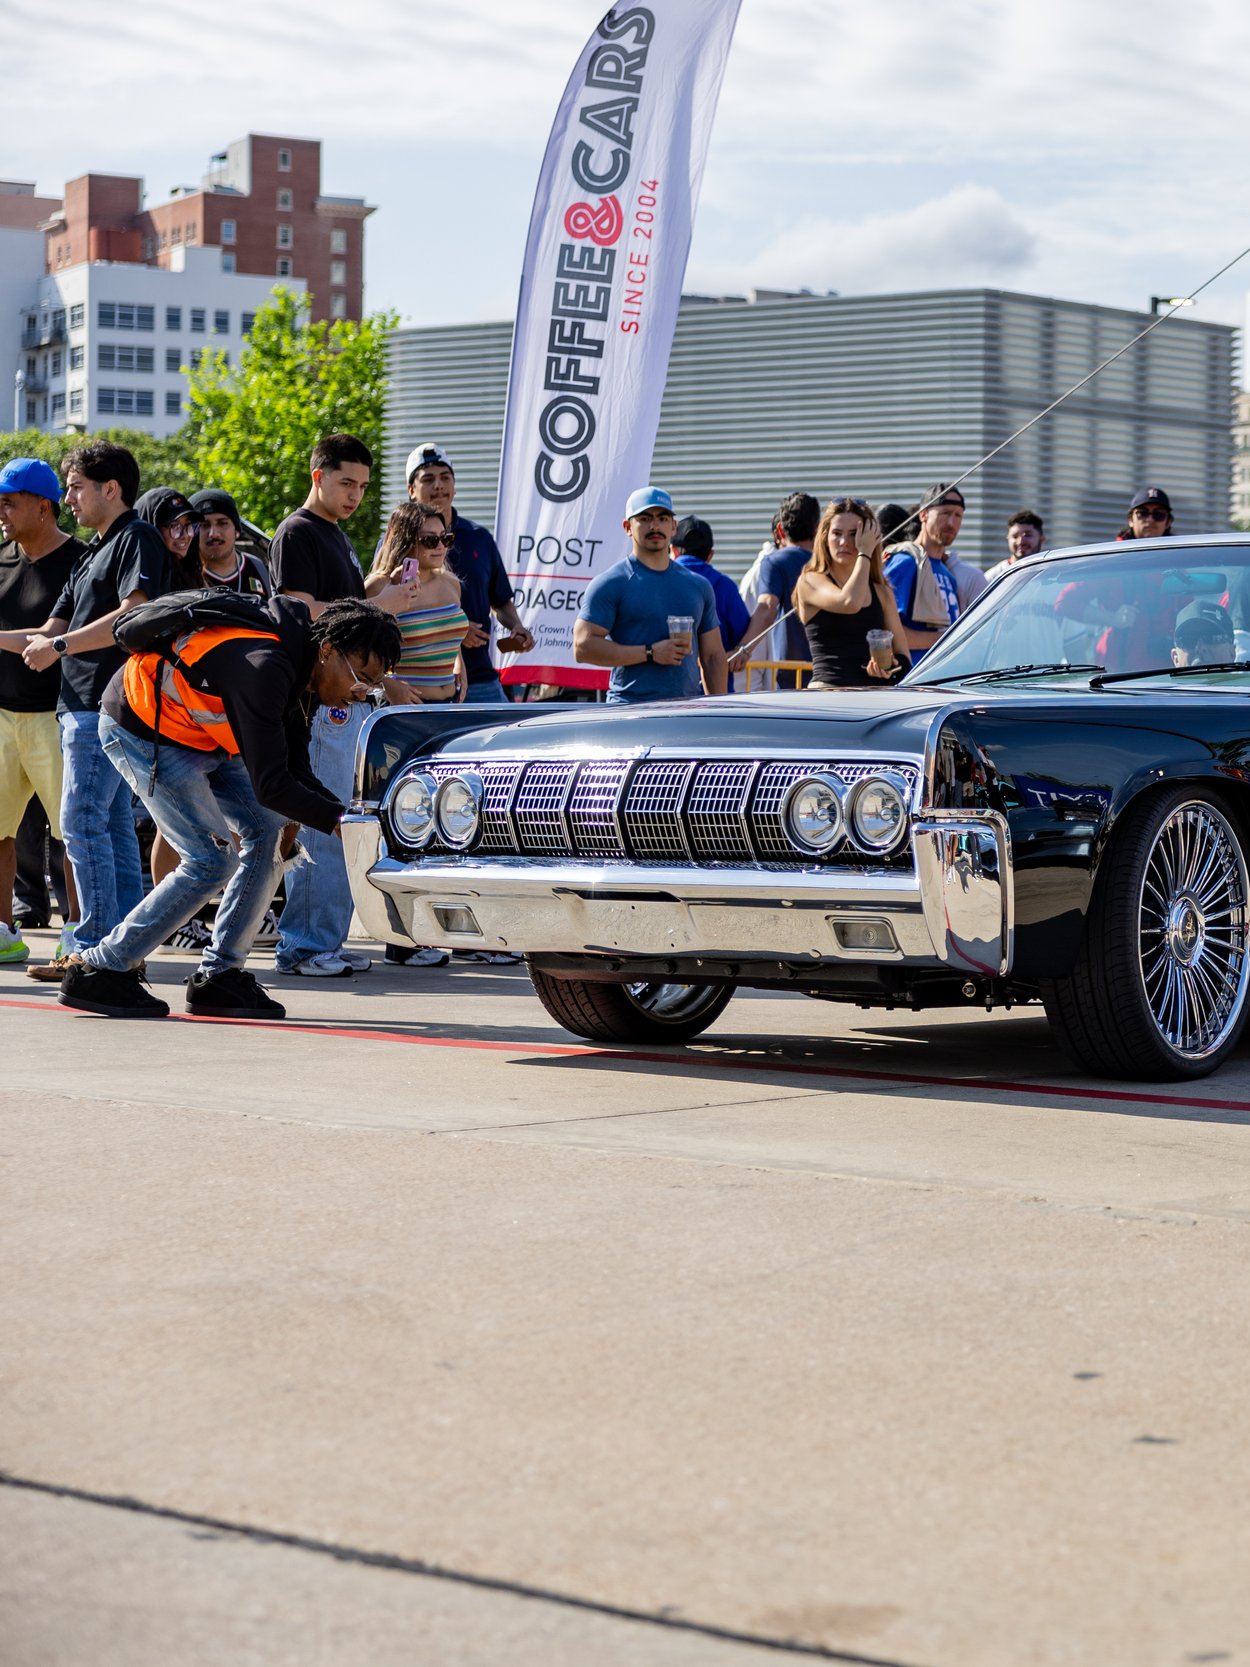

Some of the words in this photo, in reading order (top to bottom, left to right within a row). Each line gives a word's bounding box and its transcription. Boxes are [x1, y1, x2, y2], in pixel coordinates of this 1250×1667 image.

[633, 179, 659, 240] 2004
[620, 252, 649, 335] SINCE
[516, 535, 603, 568] POST
[538, 623, 565, 635] Crown
[543, 637, 574, 650] Johnny
